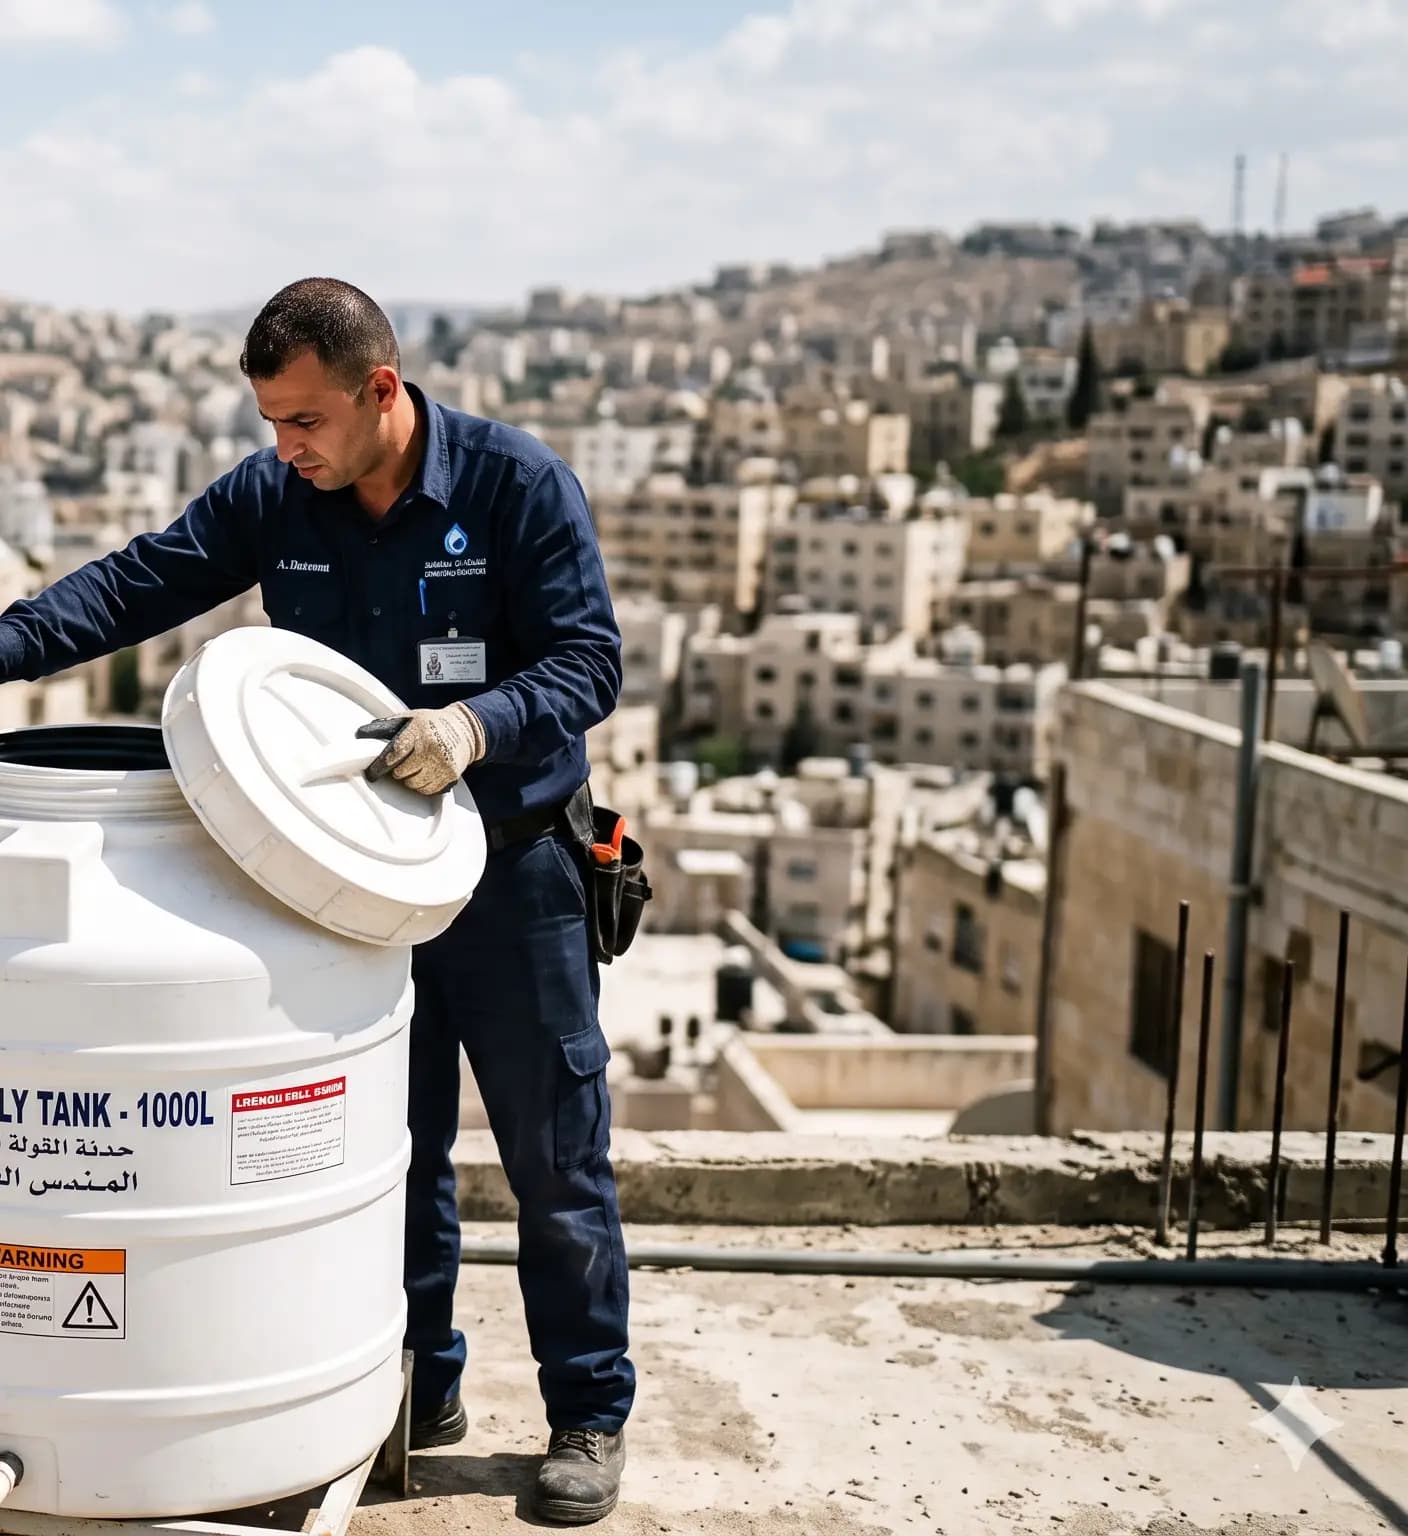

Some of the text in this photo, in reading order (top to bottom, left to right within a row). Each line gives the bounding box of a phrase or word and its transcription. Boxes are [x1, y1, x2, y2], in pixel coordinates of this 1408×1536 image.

[36, 1090, 112, 1128] TANK
[119, 1111, 128, 1120] -
[137, 1090, 214, 1128] 1000L
